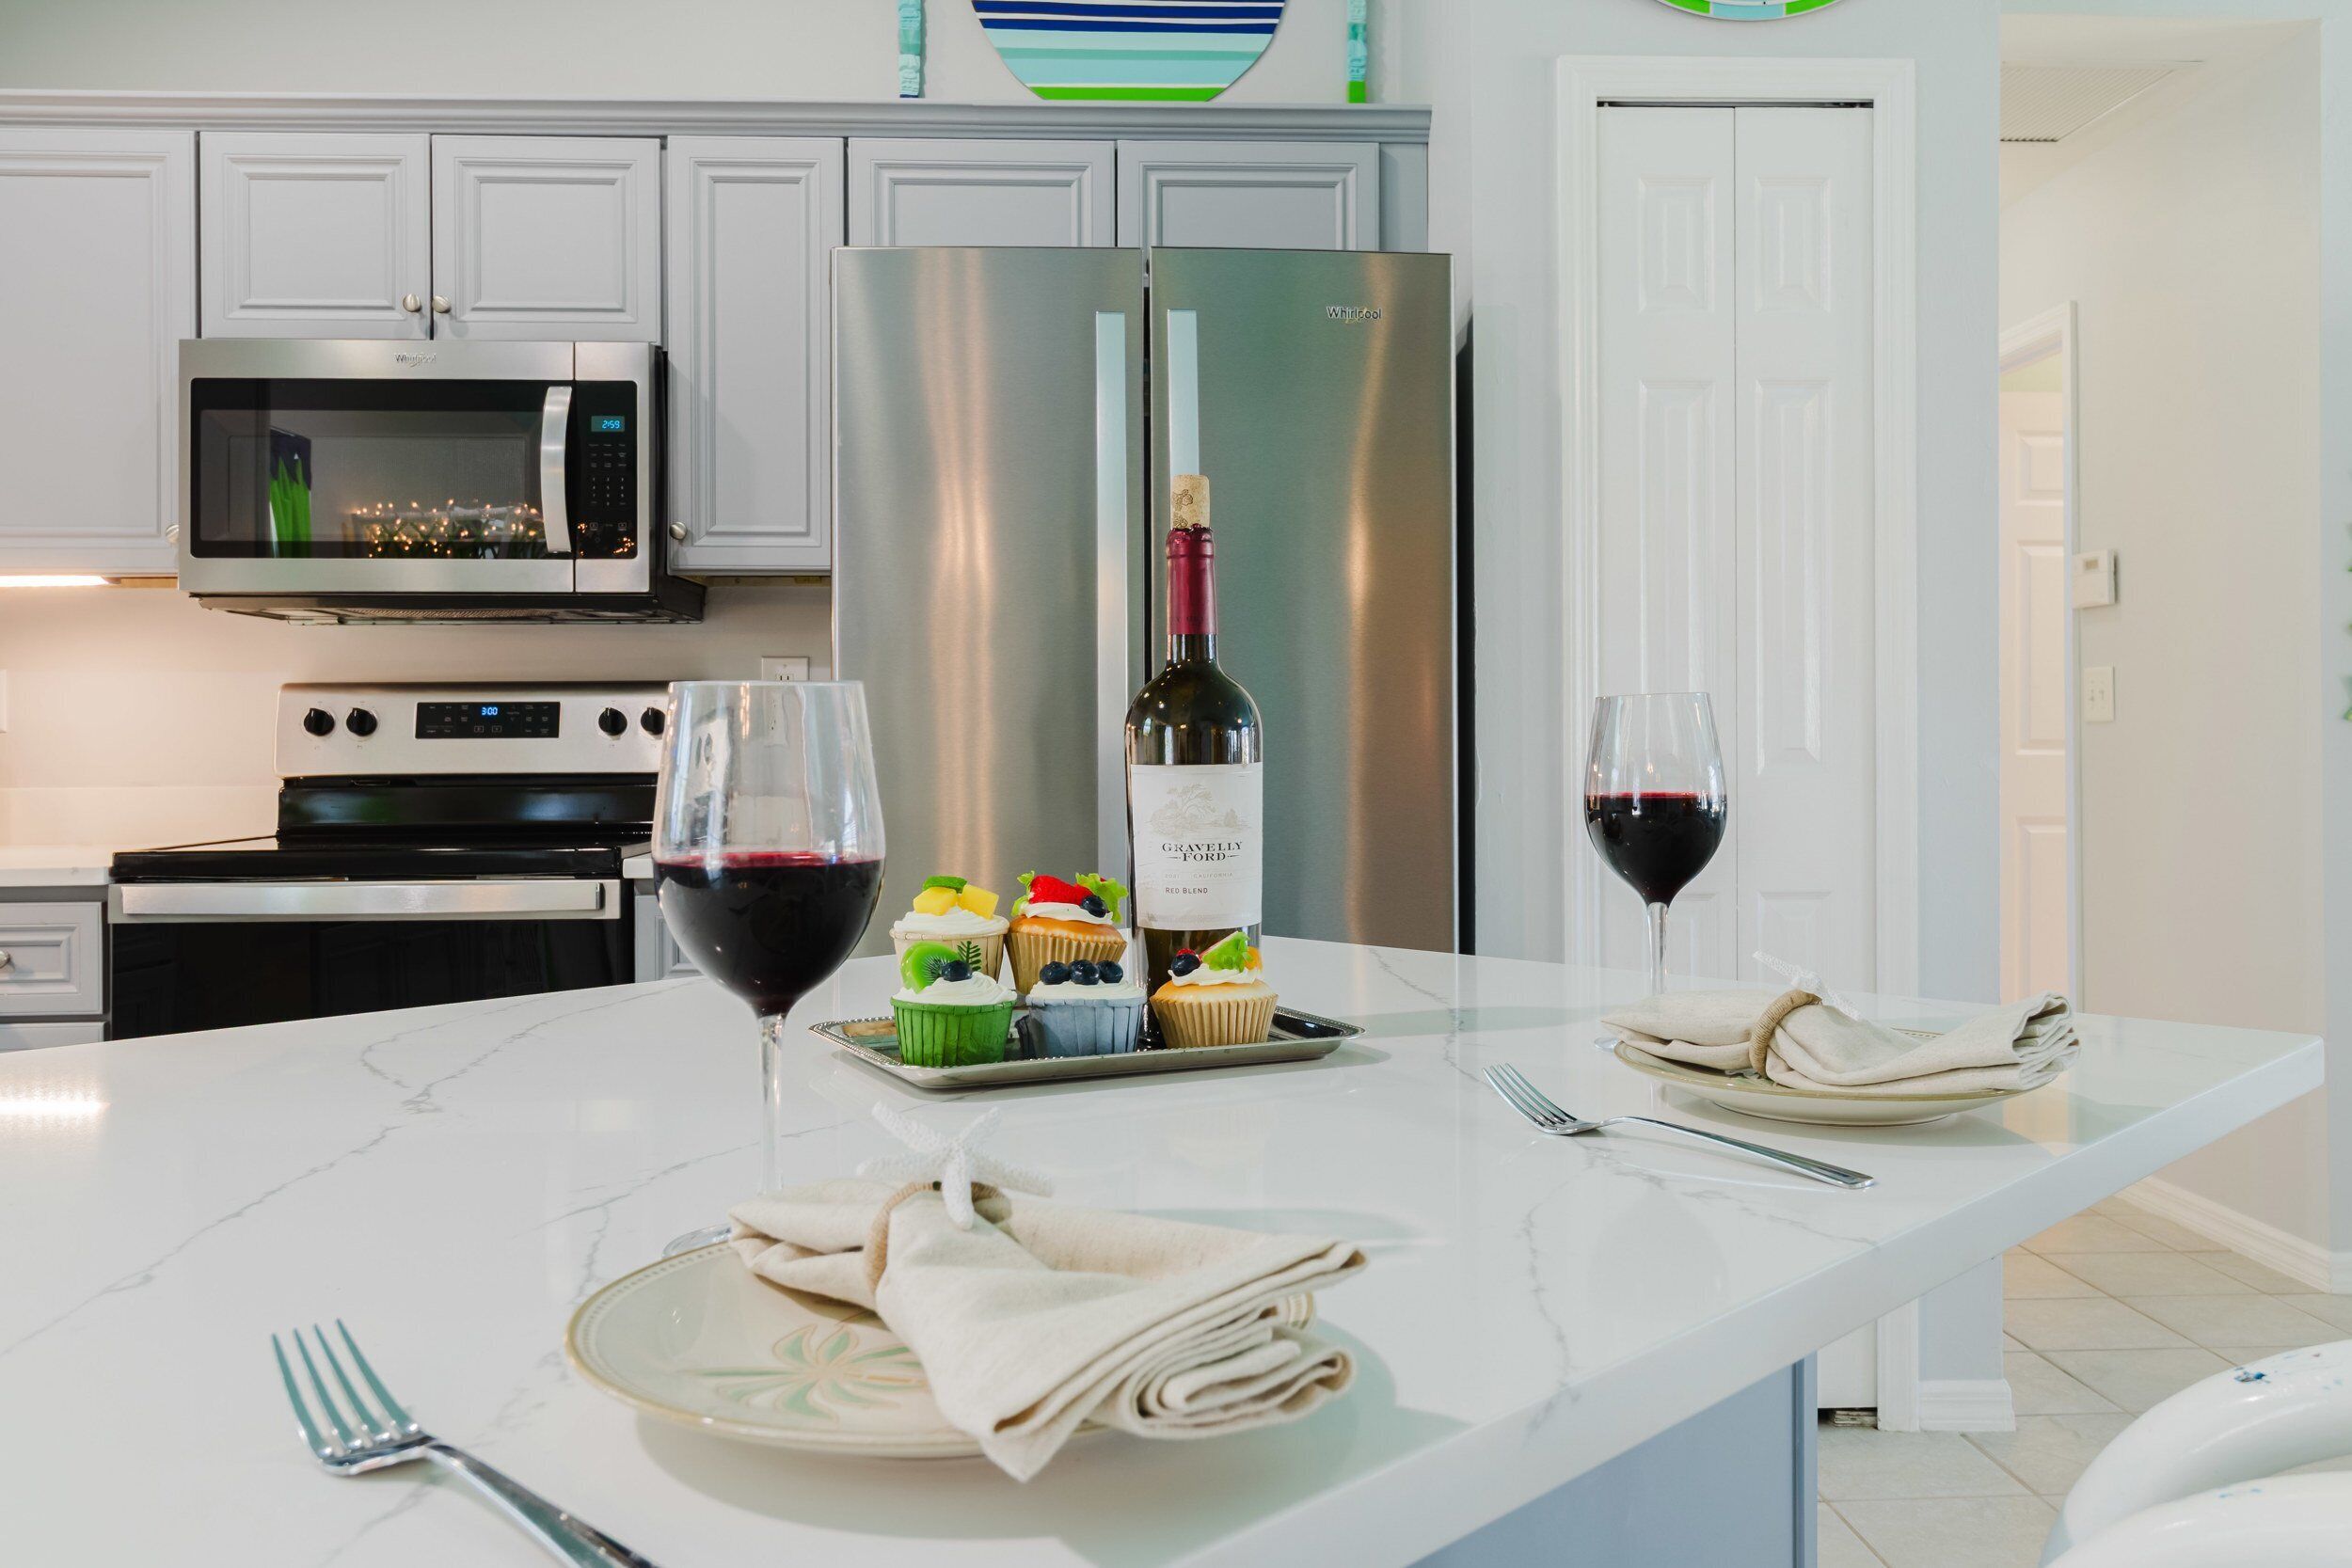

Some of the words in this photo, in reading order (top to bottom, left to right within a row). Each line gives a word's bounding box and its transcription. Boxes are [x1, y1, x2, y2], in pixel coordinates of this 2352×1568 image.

[1326, 306, 1383, 322] Whirlpool
[602, 420, 620, 429] 2:59
[482, 706, 499, 716] 3:00
[1162, 841, 1243, 853] GRAVELLY
[1183, 852, 1227, 862] FORD
[1183, 886, 1209, 895] BLEND
